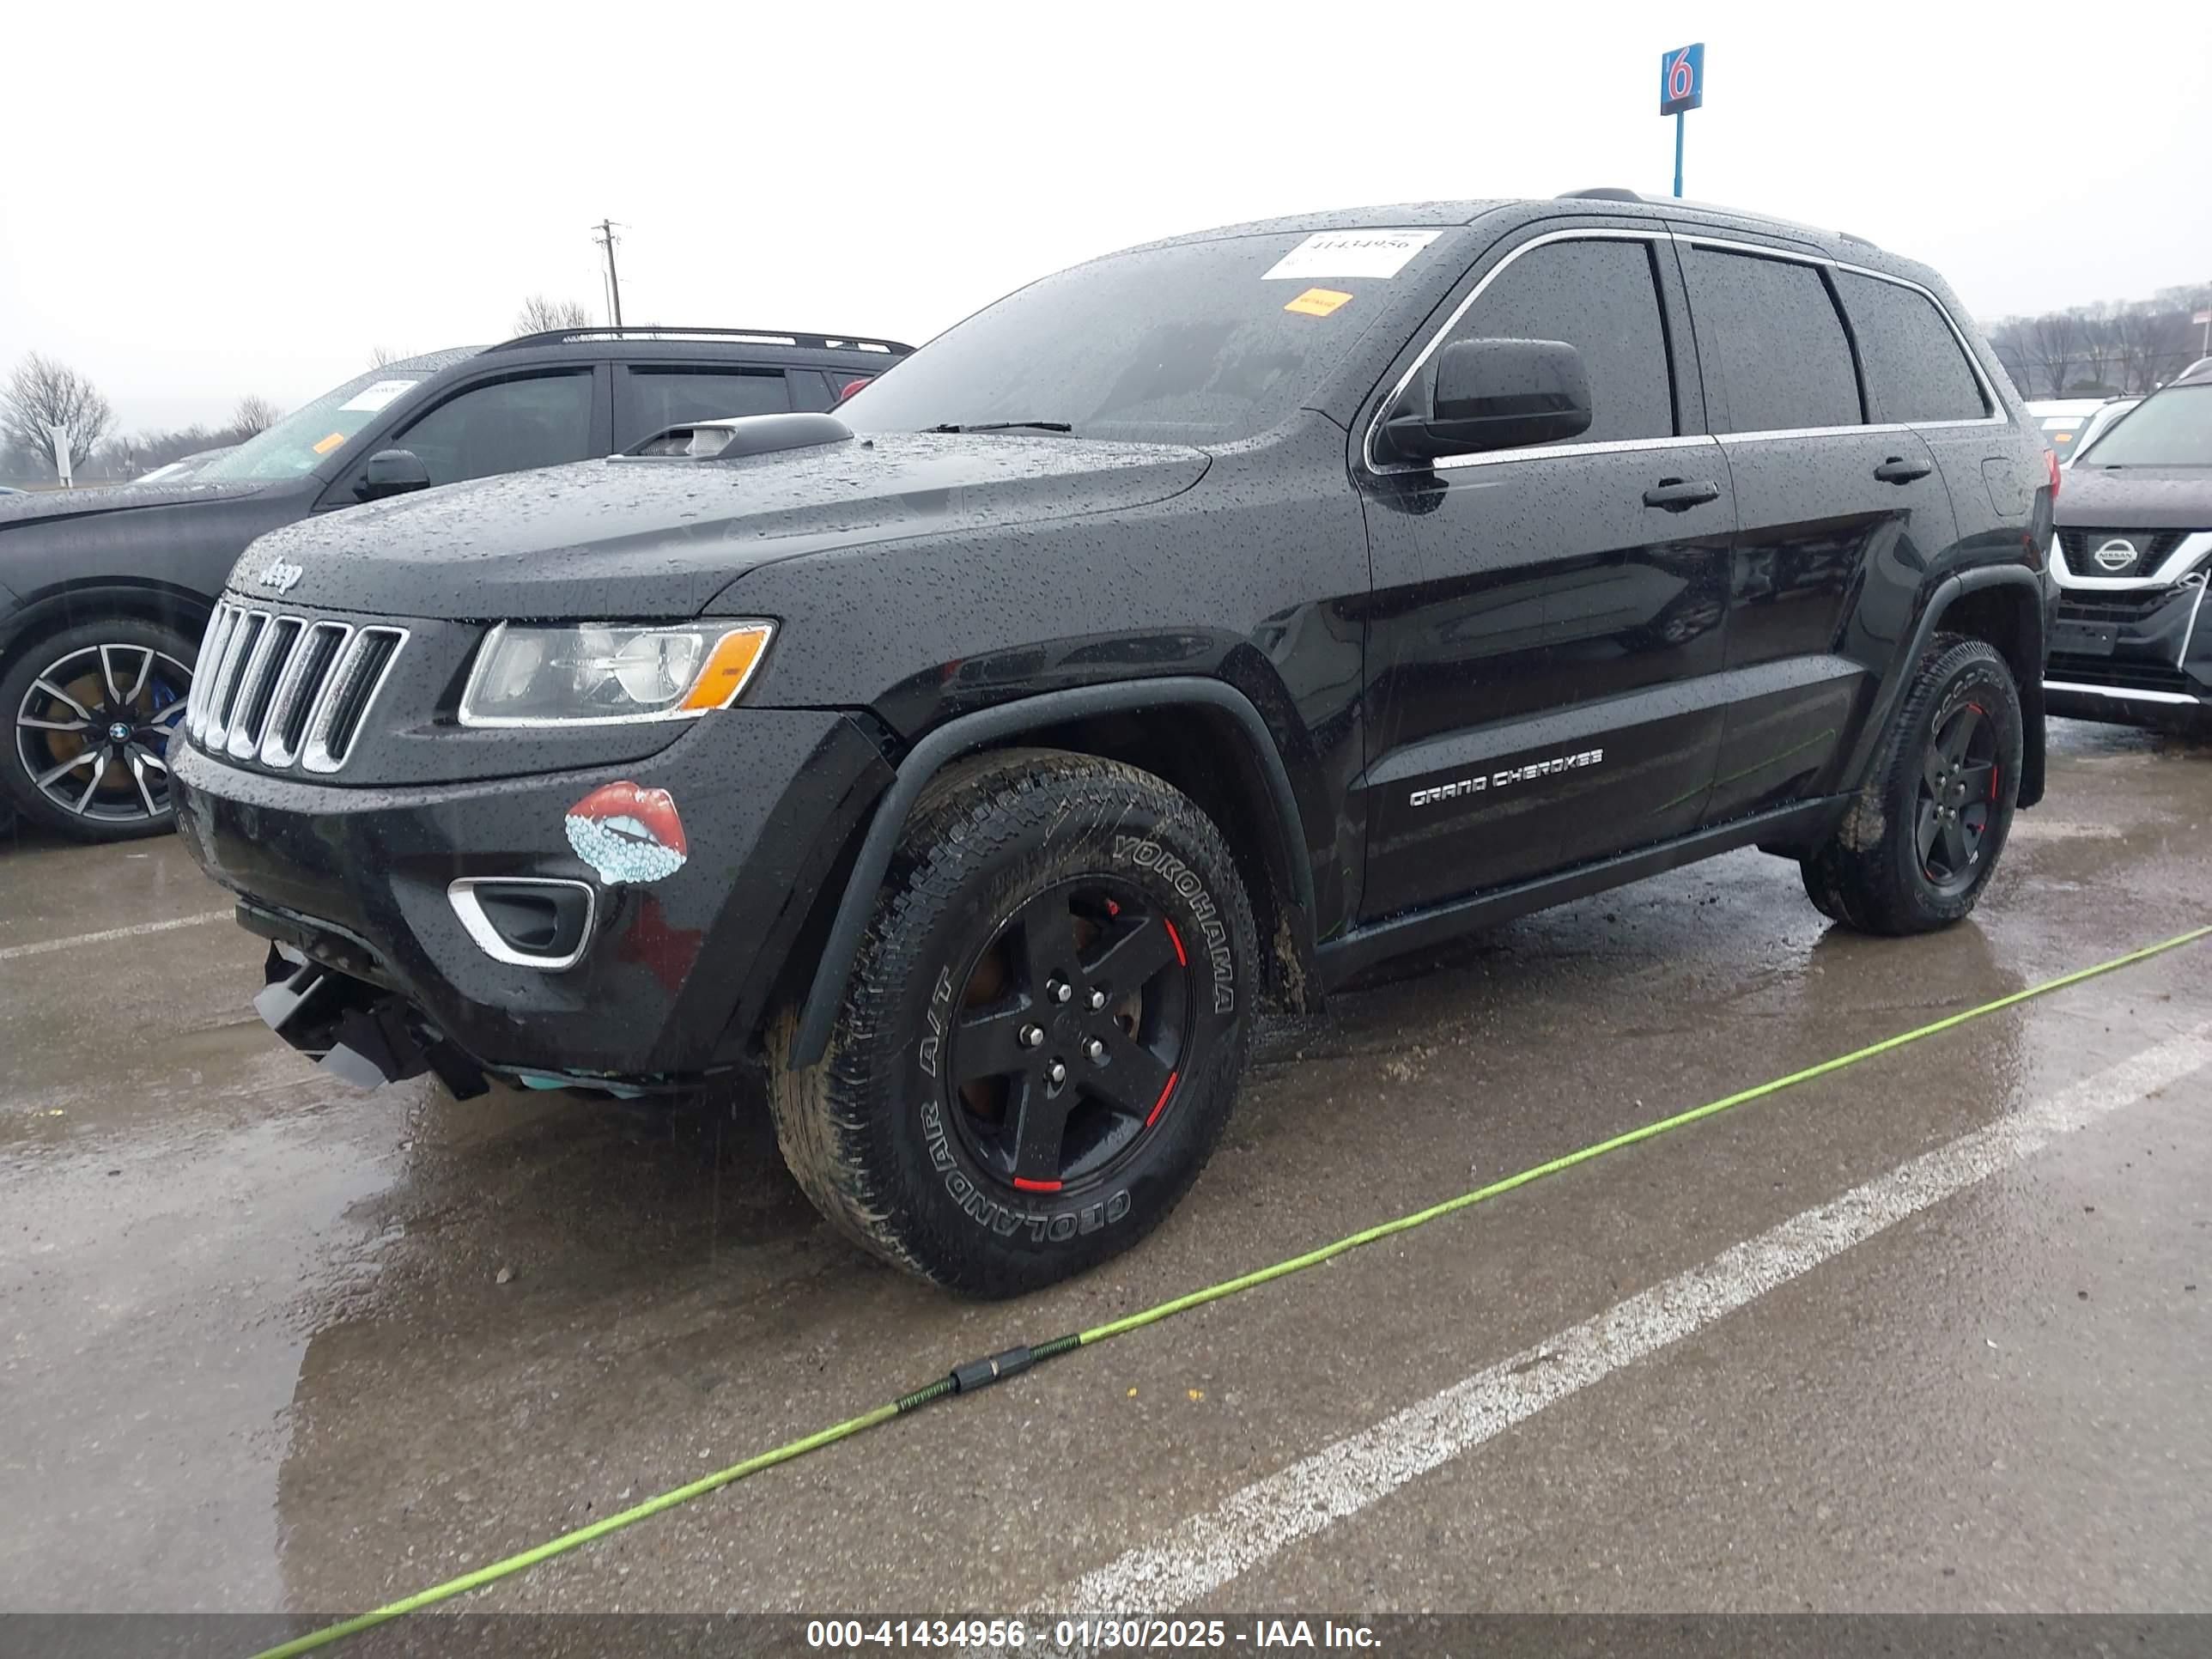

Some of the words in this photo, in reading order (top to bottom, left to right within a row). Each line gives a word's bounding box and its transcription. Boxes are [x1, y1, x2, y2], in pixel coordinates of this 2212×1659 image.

[1668, 46, 1693, 100] 6
[1409, 775, 1487, 806] GRAND
[1492, 748, 1604, 788] CHEROKEE
[1113, 835, 1234, 1014] YOKOHAMA
[919, 964, 951, 1079] A/T
[920, 1099, 1133, 1243] GEOLANDAR
